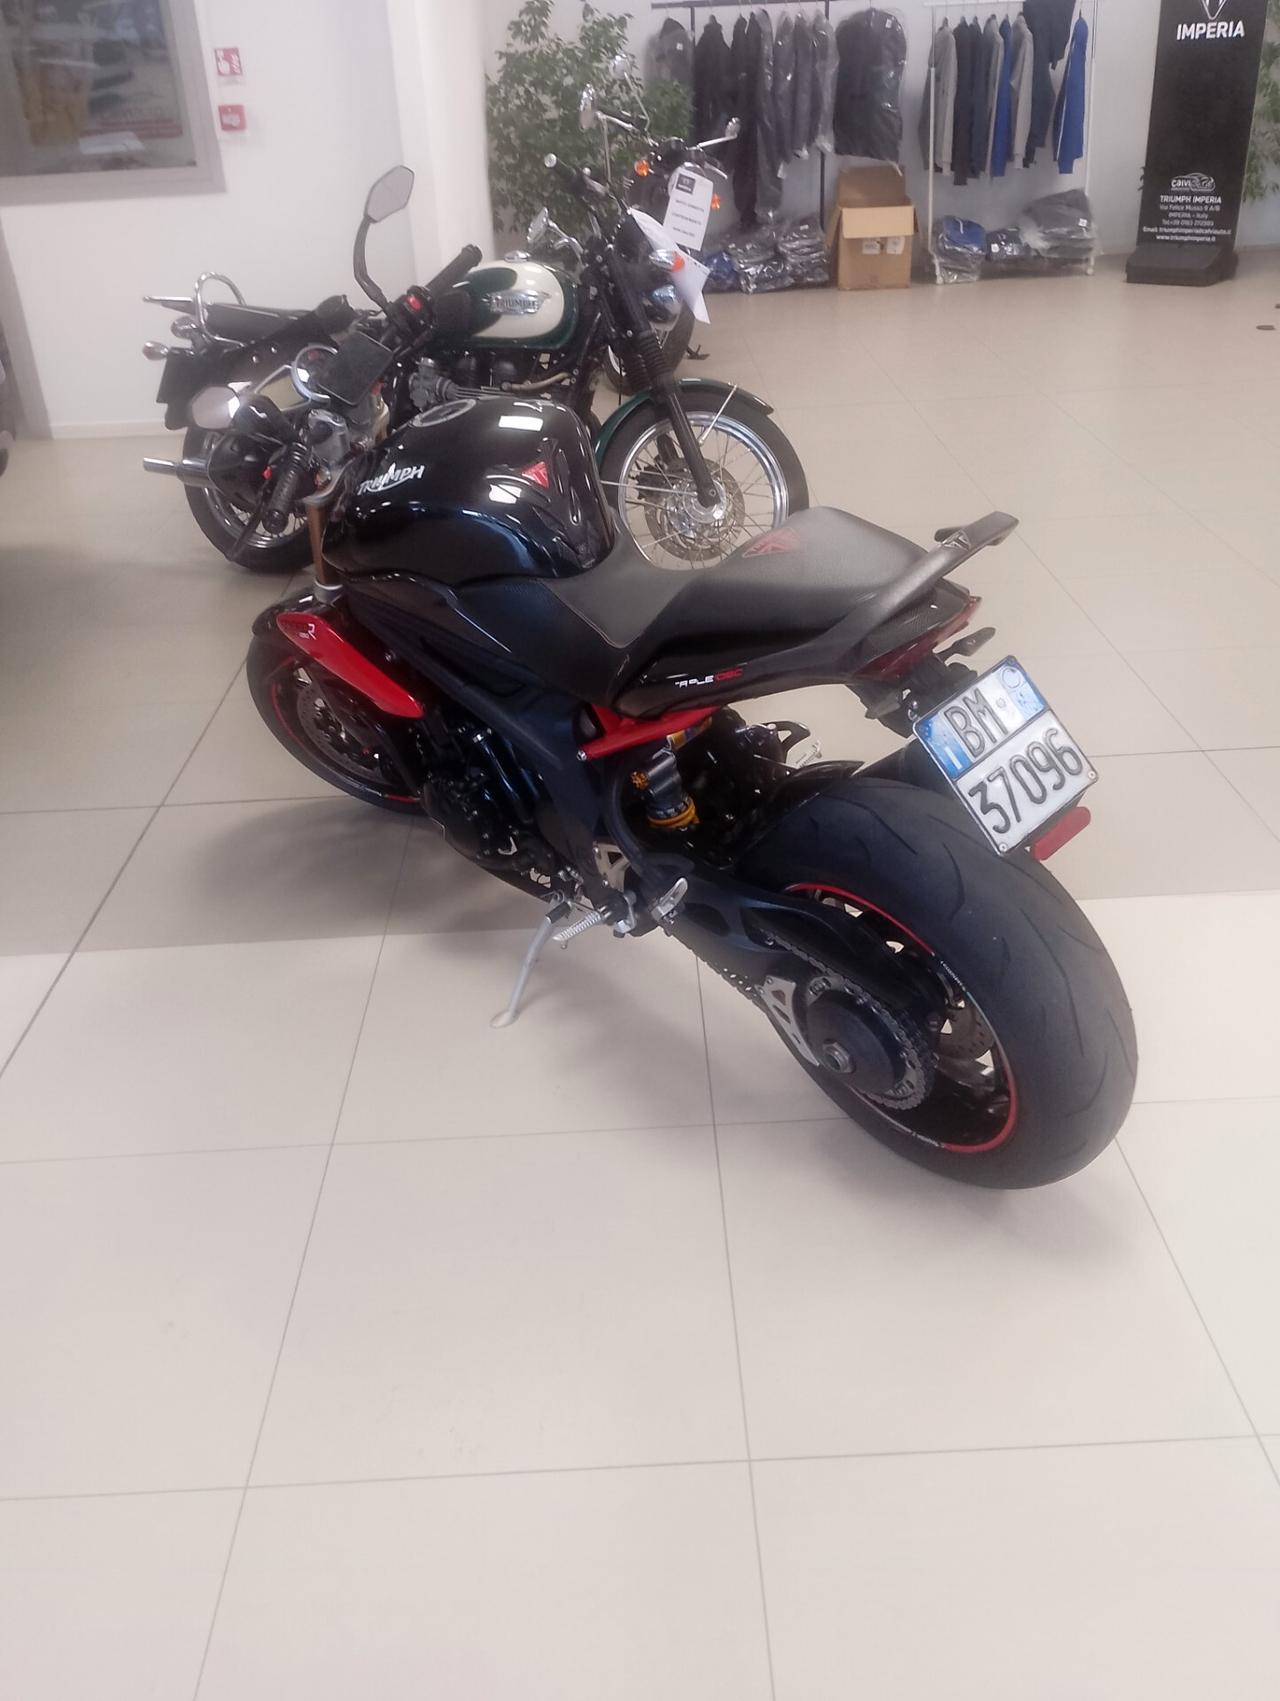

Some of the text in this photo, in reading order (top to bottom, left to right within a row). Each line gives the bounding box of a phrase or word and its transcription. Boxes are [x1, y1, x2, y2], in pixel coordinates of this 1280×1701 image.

[1176, 20, 1245, 40] IMPERIA
[1160, 195, 1222, 204] TRIUMPH IMPERIA
[357, 462, 425, 495] TRIUMPH
[943, 687, 1009, 759] BM
[968, 728, 1083, 834] 37096
